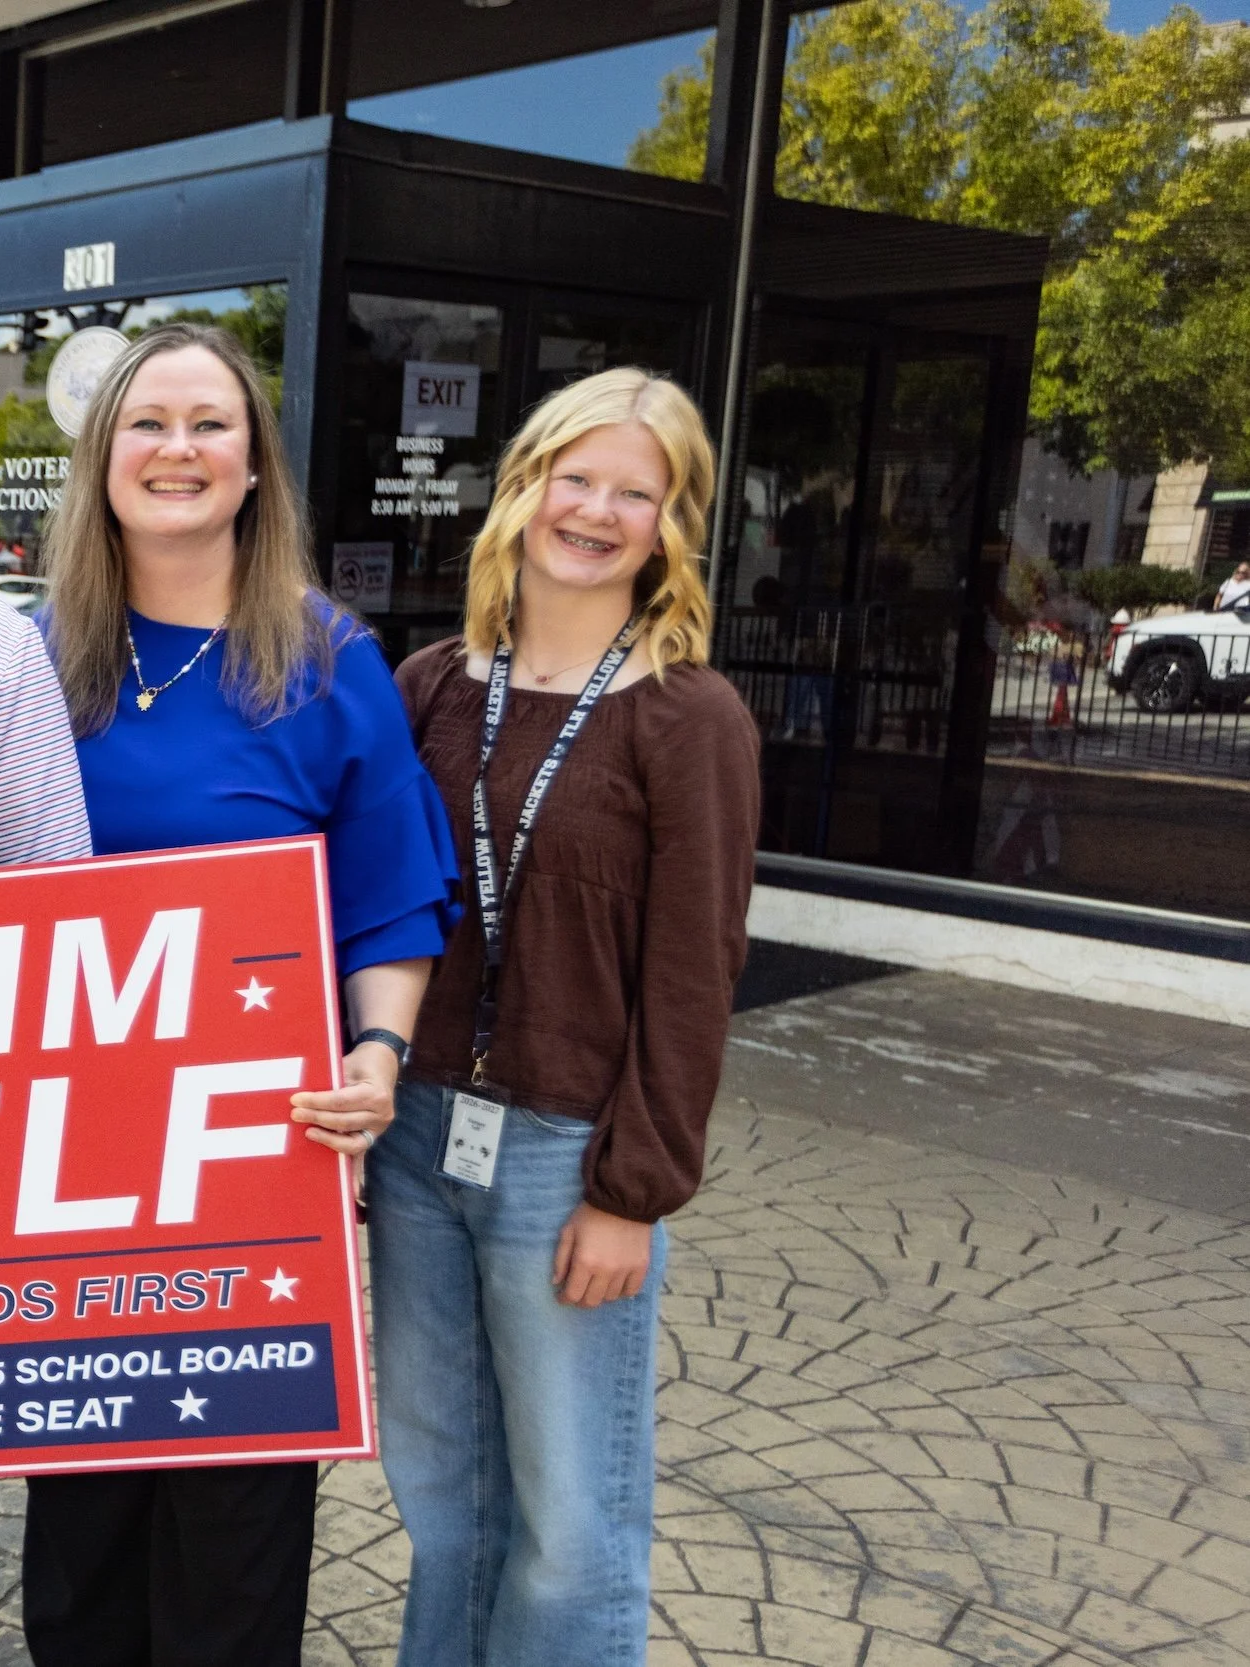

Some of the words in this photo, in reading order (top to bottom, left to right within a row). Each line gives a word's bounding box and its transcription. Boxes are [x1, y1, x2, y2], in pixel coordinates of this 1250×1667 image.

[418, 377, 466, 407] EXIT
[396, 436, 444, 454] BUSINESS
[5, 457, 71, 481] VOTER
[375, 478, 417, 494] MONDAY
[425, 480, 459, 496] FRIDAY
[395, 500, 412, 516] AM
[443, 501, 460, 517] PM
[486, 660, 507, 726] JACKETS
[559, 710, 587, 738] TLH
[577, 647, 625, 706] YELLOW
[519, 758, 558, 829] JACKETS
[475, 838, 496, 908] YELLOW
[73, 1266, 248, 1318] FIRST
[15, 1350, 171, 1385] SCHOOL
[178, 1342, 314, 1375] BOARD
[16, 1396, 133, 1433] SEAT
